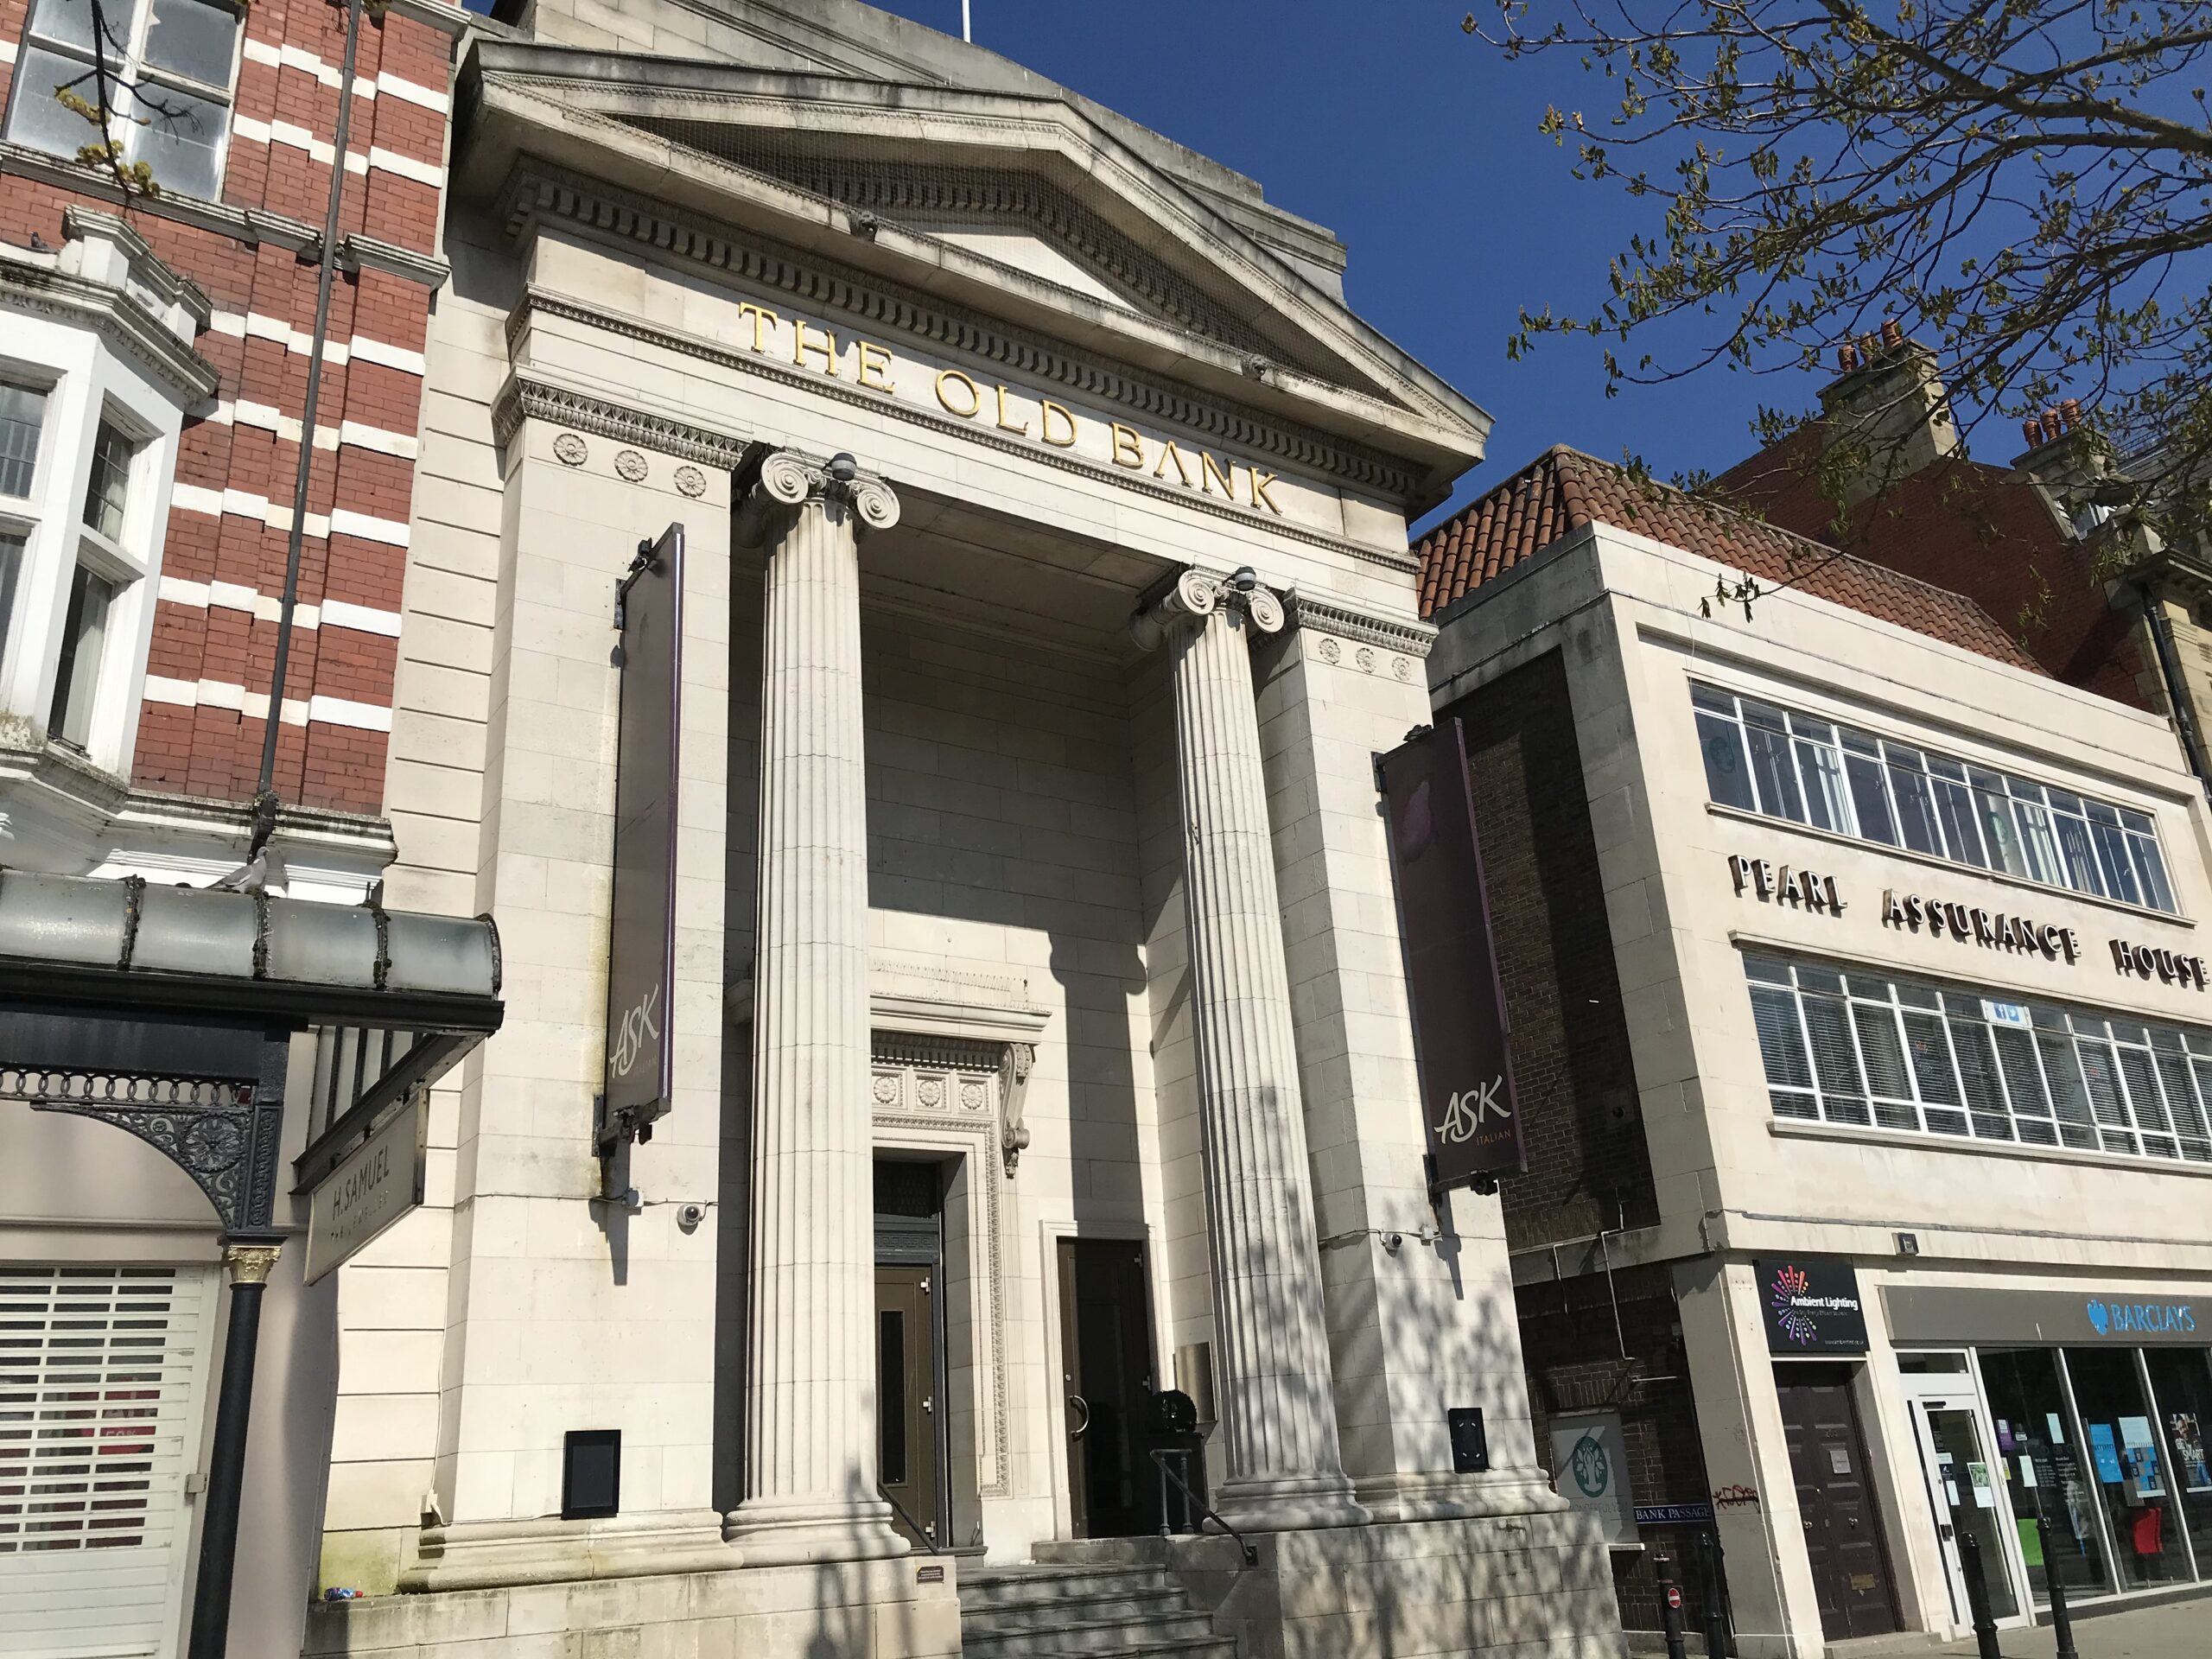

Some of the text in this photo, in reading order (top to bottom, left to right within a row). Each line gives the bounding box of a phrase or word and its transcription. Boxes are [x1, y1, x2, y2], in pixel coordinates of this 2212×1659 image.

[740, 302, 1283, 515] THE OLD BANK
[1729, 854, 2210, 991] PEARL ASSURANCE HOUSE
[609, 982, 660, 1079] ASK
[1433, 1074, 1511, 1145] ASK
[1476, 1128, 1511, 1147] ITALIAN
[332, 1145, 390, 1221] H.SAMUEL
[1790, 1295, 1859, 1312] Ambient Lighting
[2110, 1304, 2196, 1333] BARCLAYS
[1636, 1508, 1666, 1520] BANK
